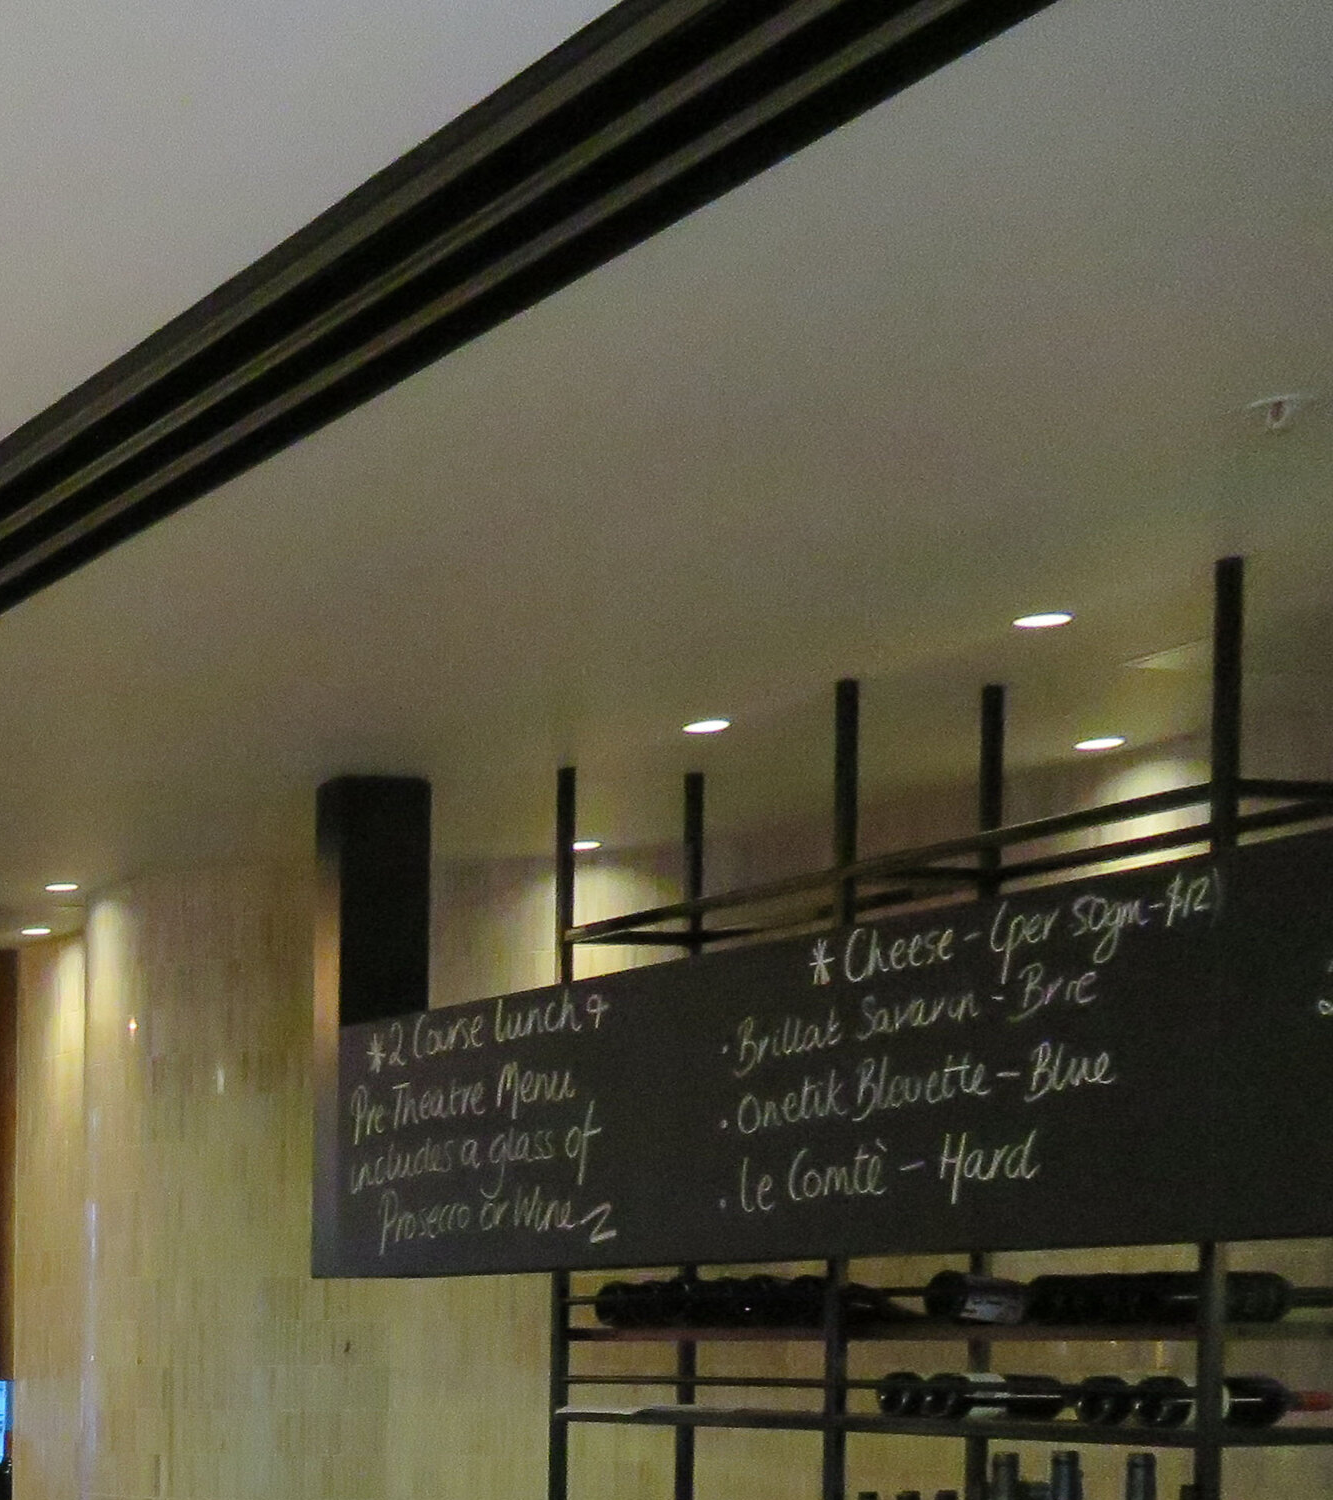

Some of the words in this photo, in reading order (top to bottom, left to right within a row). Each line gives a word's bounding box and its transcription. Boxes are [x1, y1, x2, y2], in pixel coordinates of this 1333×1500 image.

[845, 928, 954, 983] Cheese
[388, 1021, 406, 1066] 2
[734, 1008, 841, 1078] Brillat
[1008, 963, 1097, 1023] Brie
[392, 1079, 485, 1130] Theatre
[496, 1060, 576, 1120] Menu
[1025, 1041, 1117, 1102] Blue
[350, 1137, 454, 1195] includes
[461, 1138, 481, 1169] a
[481, 1127, 554, 1199] glass
[565, 1100, 602, 1186] of
[940, 1130, 1040, 1204] Hard
